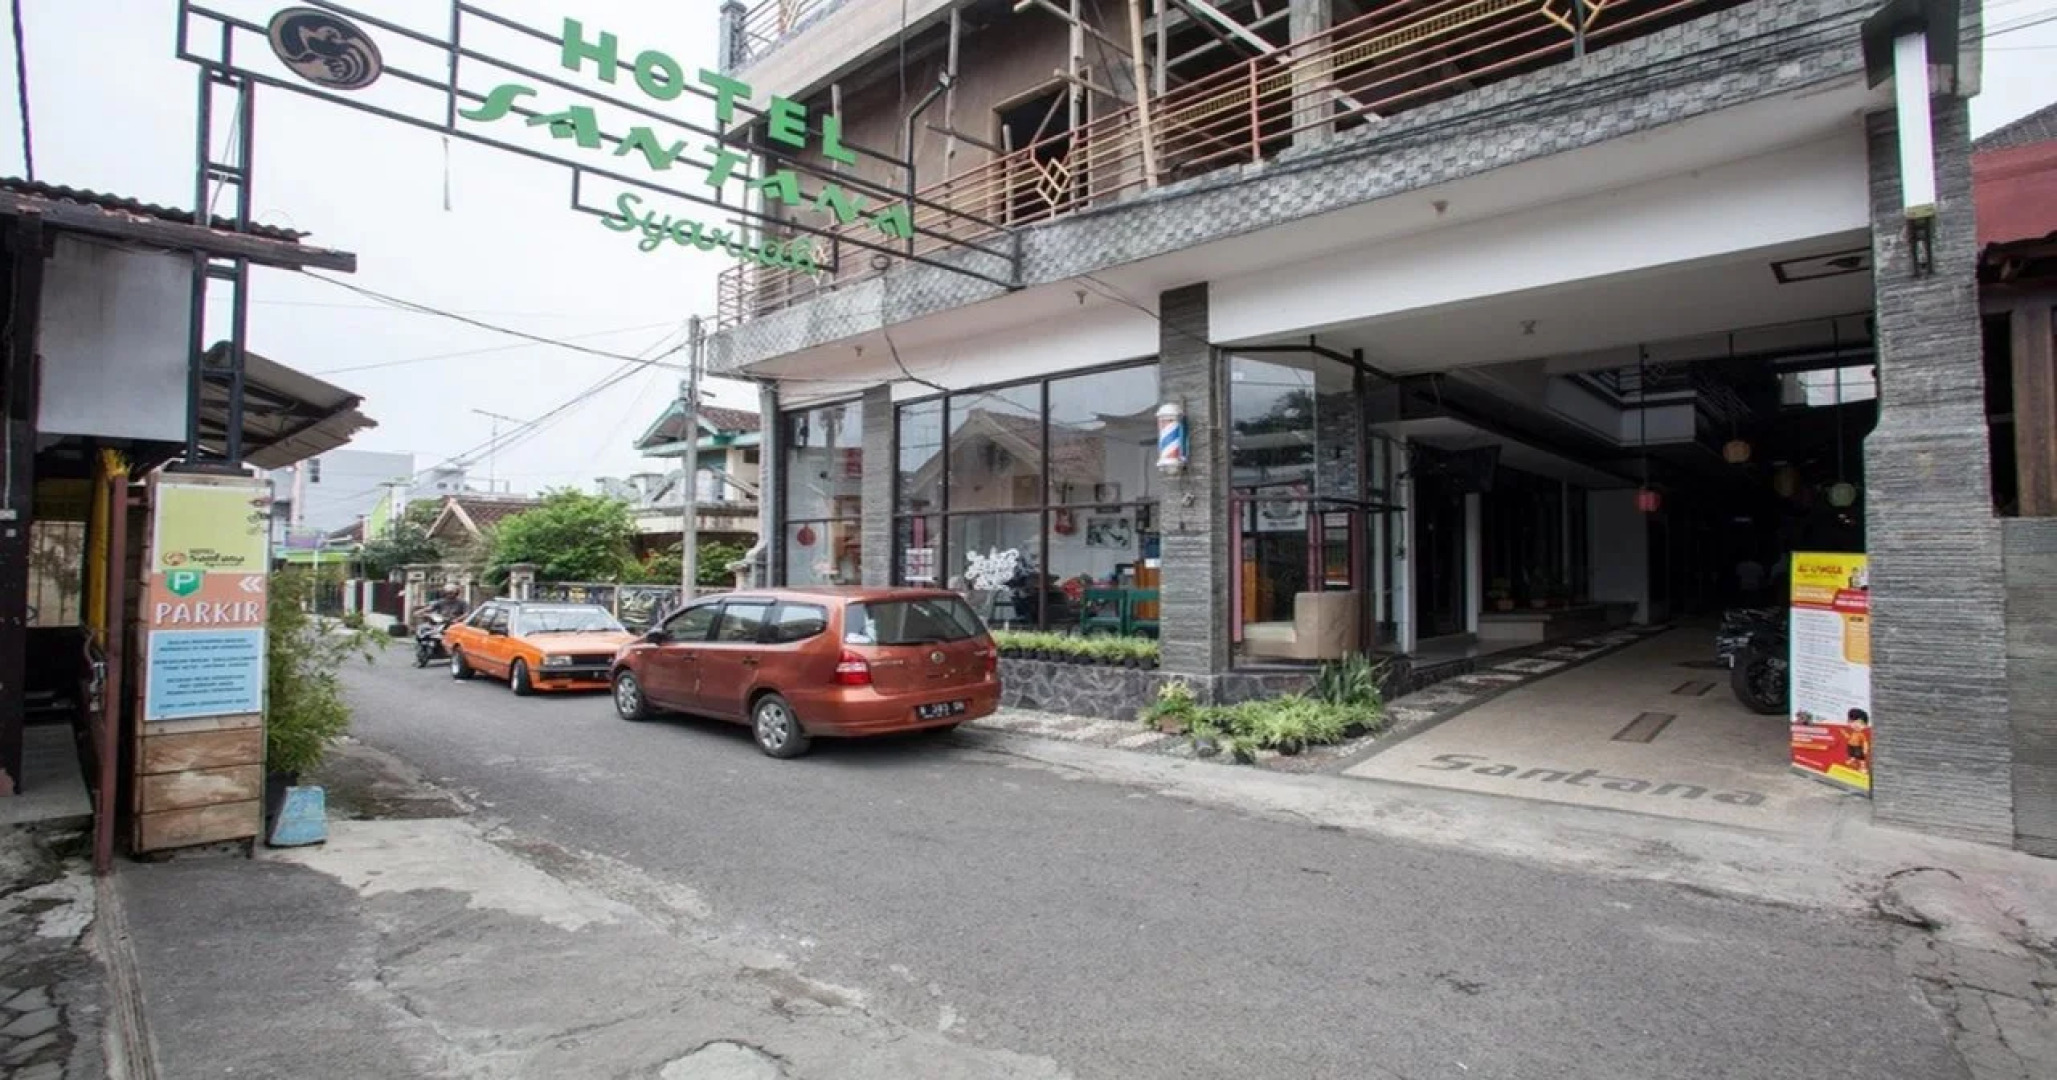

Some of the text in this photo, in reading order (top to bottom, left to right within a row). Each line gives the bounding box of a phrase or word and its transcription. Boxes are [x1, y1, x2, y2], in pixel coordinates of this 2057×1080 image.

[561, 17, 856, 166] HOTEL
[458, 83, 914, 239] SANTANA
[174, 571, 195, 590] P
[155, 602, 261, 625] PARKIR
[1416, 753, 1767, 807] Santana
